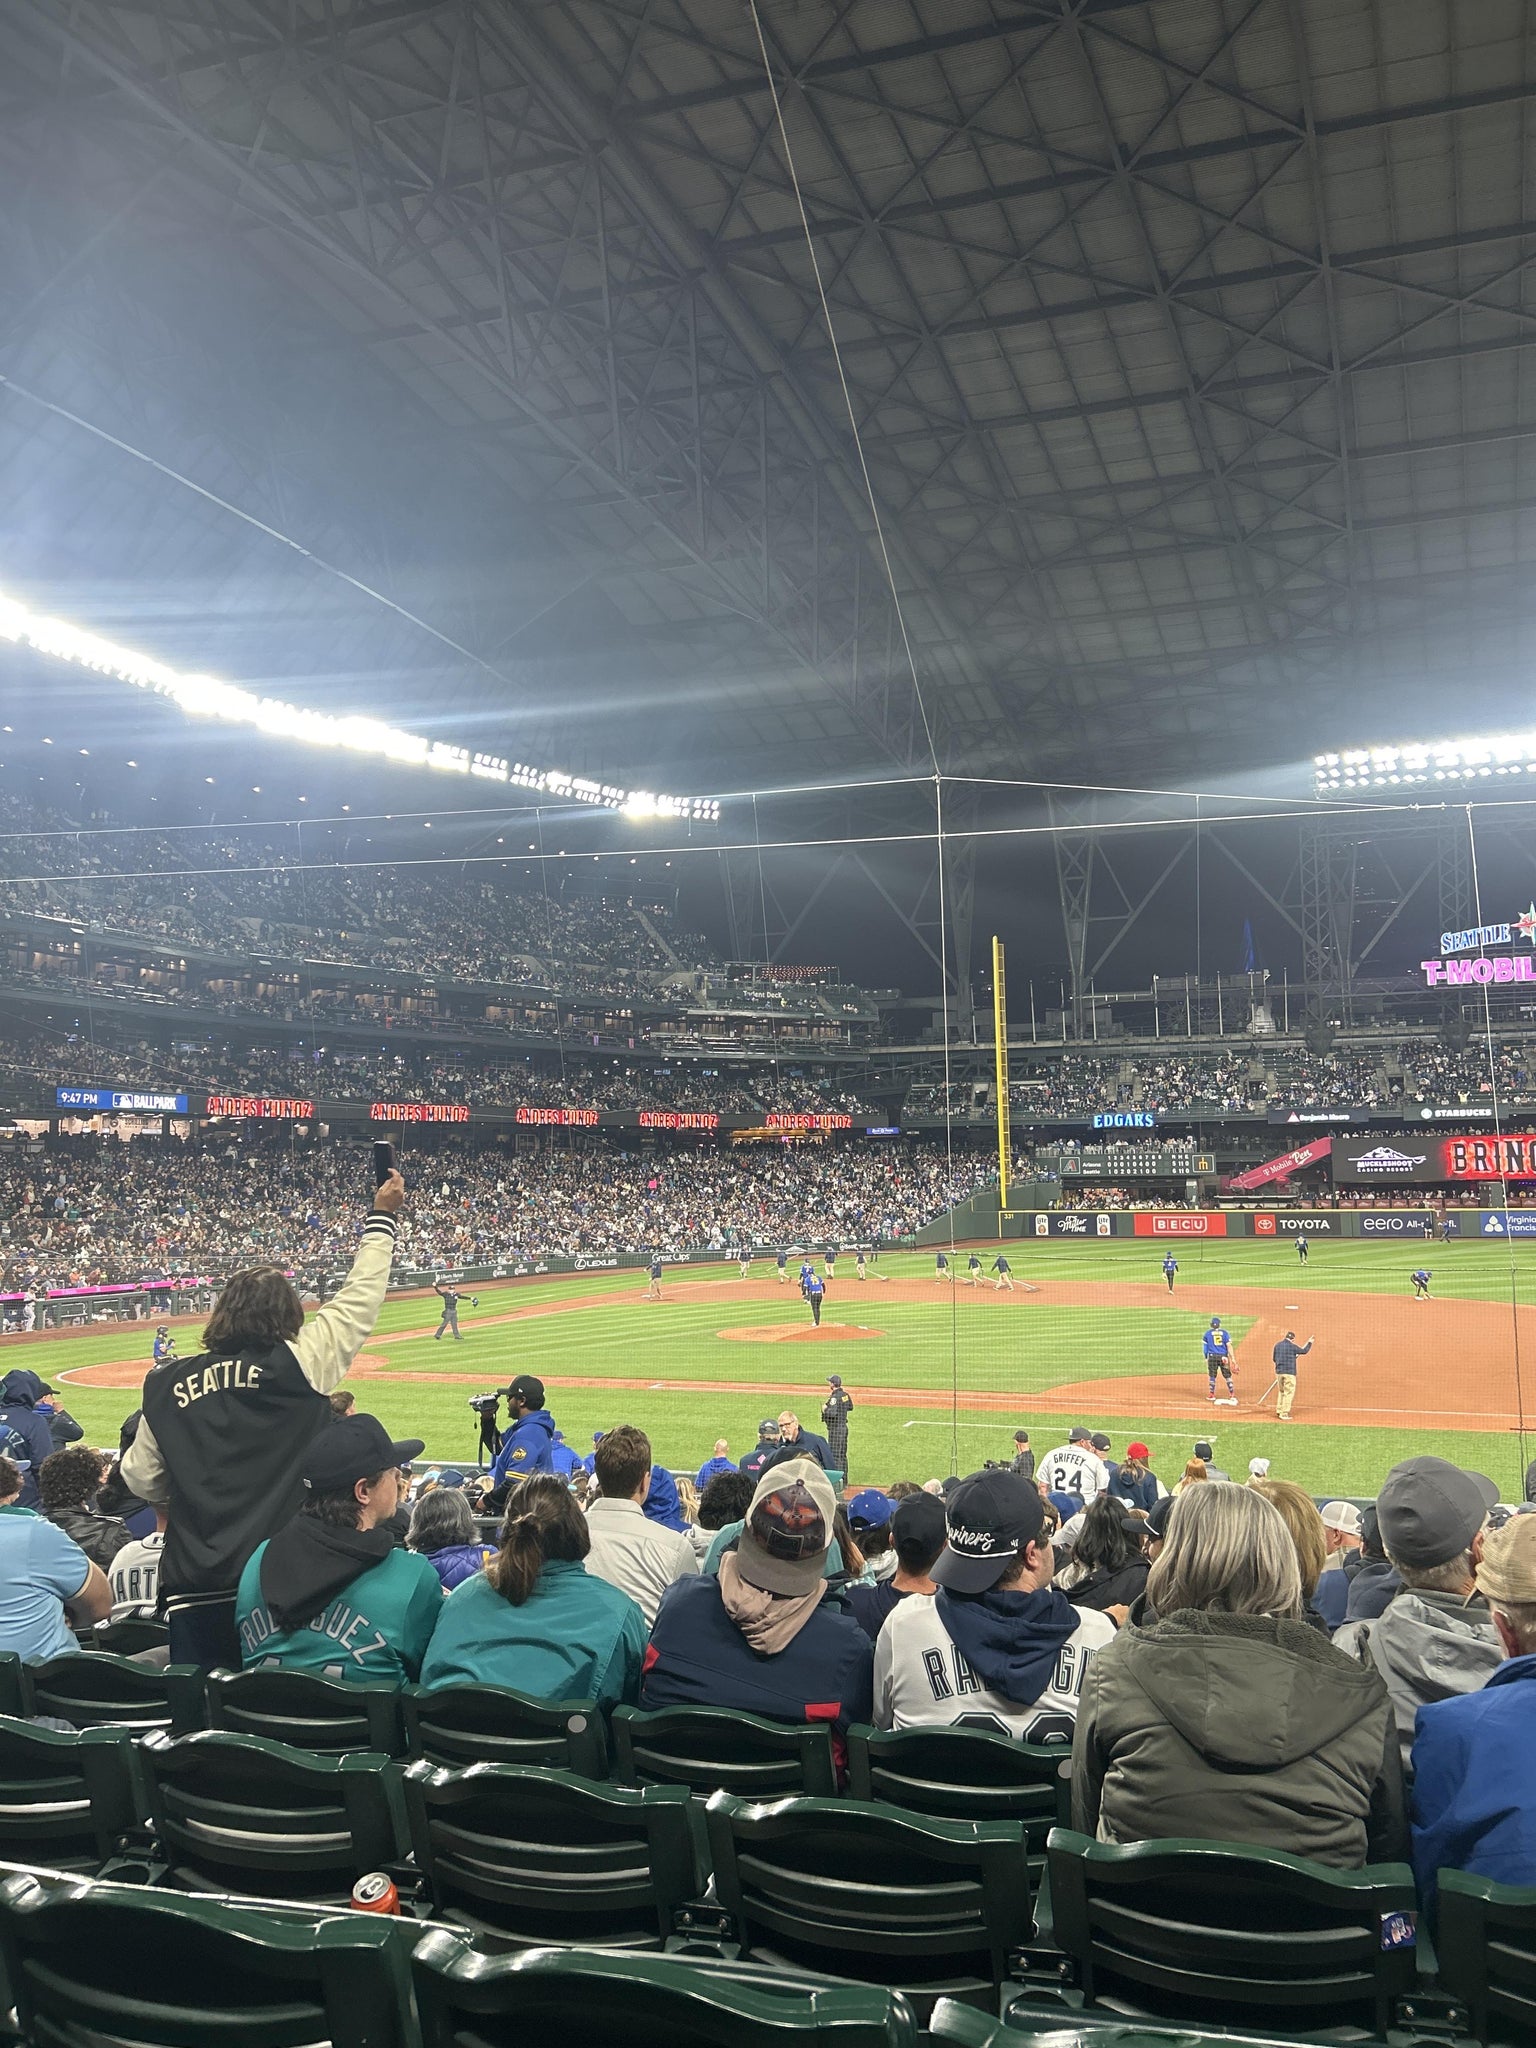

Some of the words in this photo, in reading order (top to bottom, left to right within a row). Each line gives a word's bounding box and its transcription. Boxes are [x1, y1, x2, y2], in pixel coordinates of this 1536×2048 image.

[61, 1092, 81, 1104] 9:47
[83, 1093, 98, 1105] PM
[133, 1095, 177, 1110] BALLPARK
[208, 1096, 258, 1116] ANDRES
[372, 1103, 420, 1120] ANDRES
[516, 1108, 560, 1125] ANDRES
[640, 1113, 676, 1127] ANDRES
[1434, 1109, 1491, 1118] STARBUCKS
[766, 1115, 809, 1128] ANDRES
[1270, 1160, 1293, 1174] Mobile
[1280, 1219, 1330, 1229] TOYOTA
[1363, 1218, 1403, 1230] eero
[587, 1258, 617, 1267] LEXUS
[652, 1253, 672, 1262] Great
[672, 1253, 690, 1262] Clips
[173, 1360, 263, 1408] SEATTLE
[1053, 1453, 1086, 1467] GRIFFEY
[1054, 1467, 1082, 1493] 24
